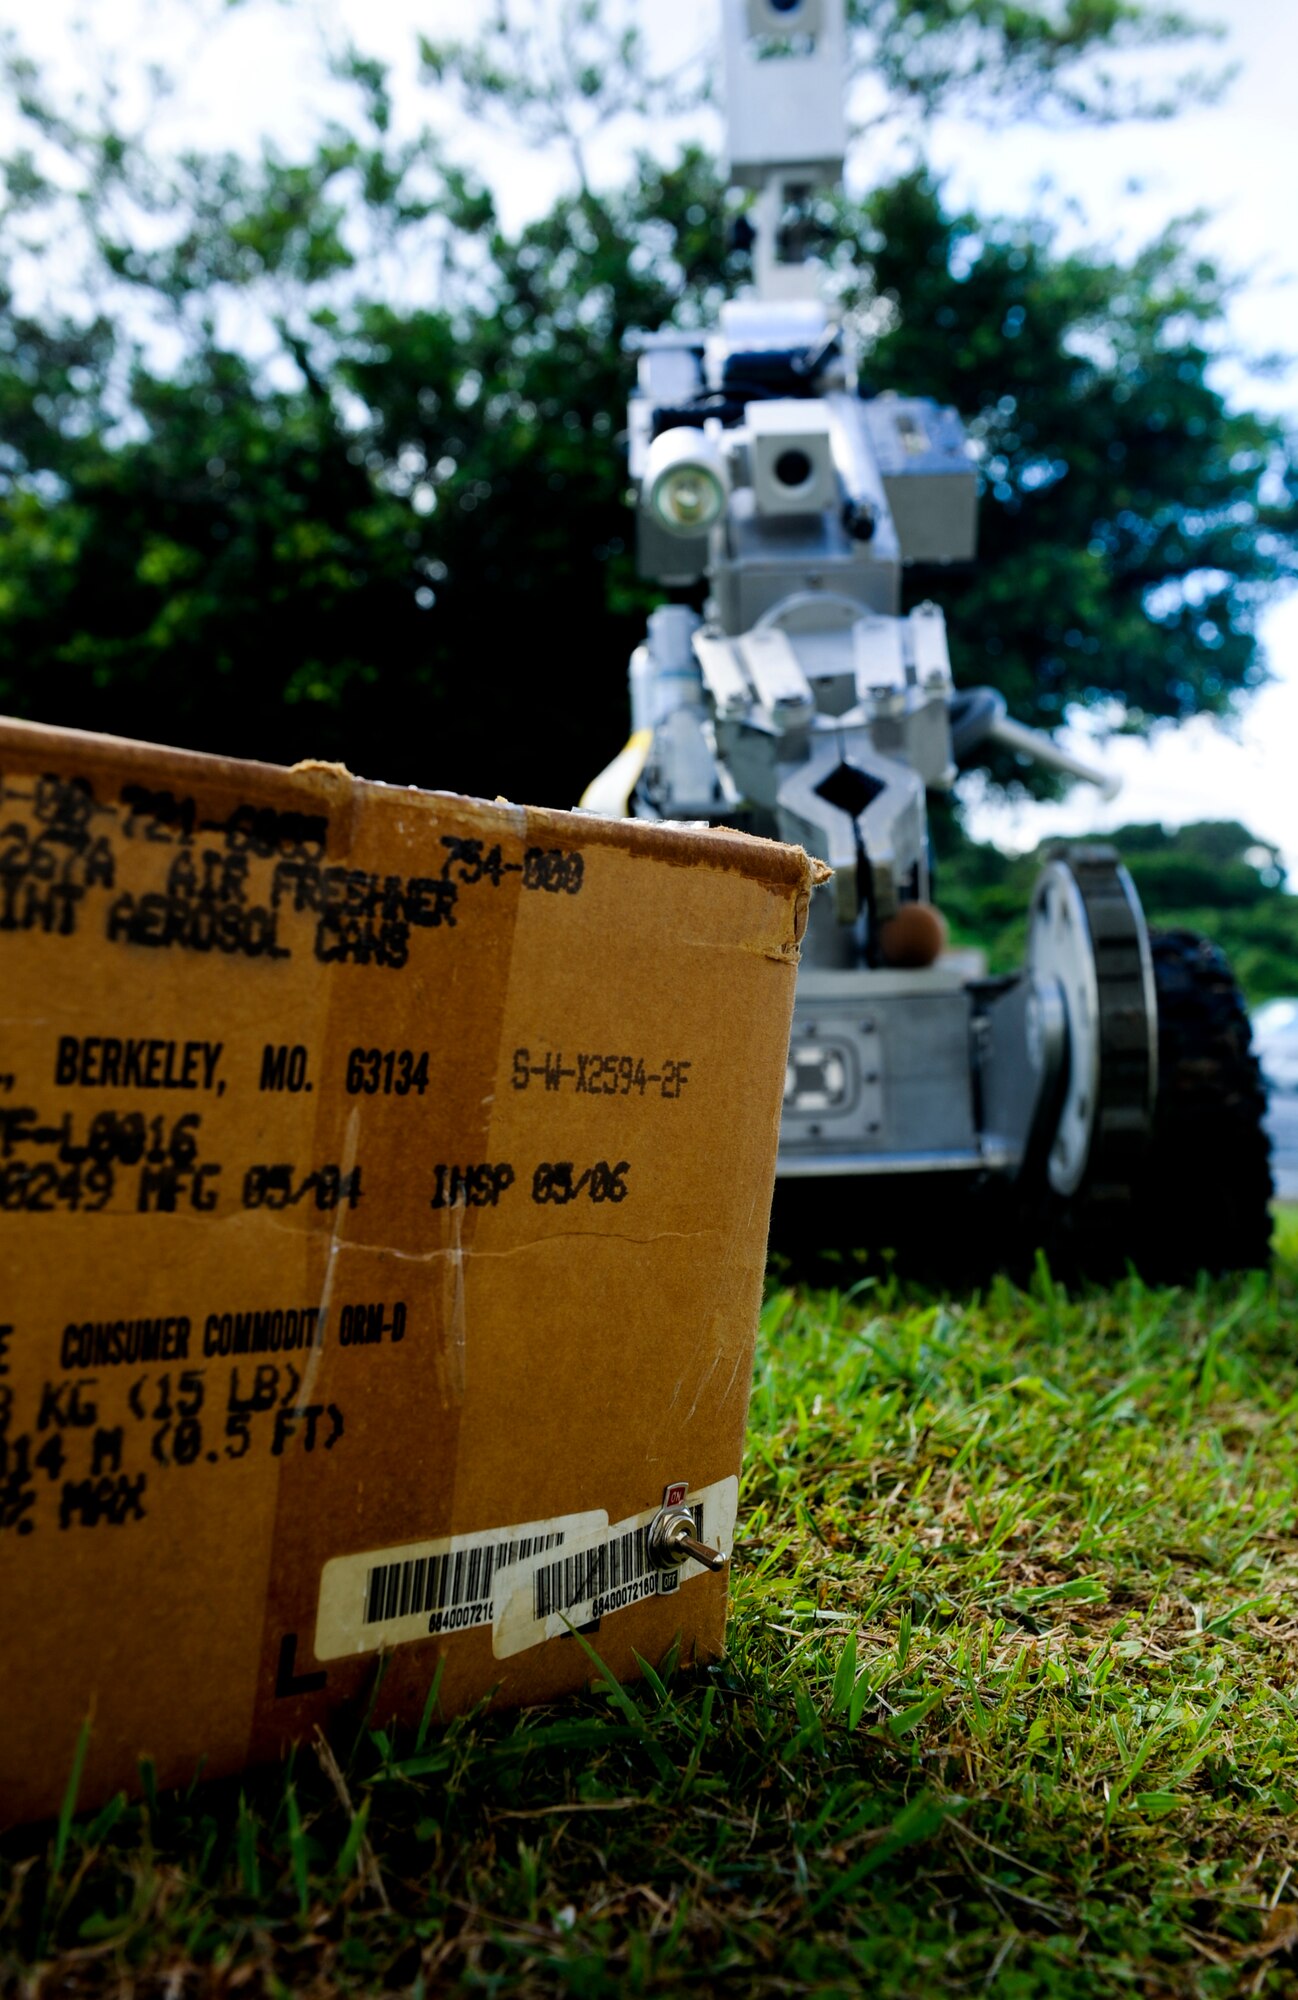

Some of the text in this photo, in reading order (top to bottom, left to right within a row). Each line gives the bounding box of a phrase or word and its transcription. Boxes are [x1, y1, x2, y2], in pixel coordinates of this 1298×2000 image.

[167, 850, 250, 904] AIR
[107, 892, 291, 960] AEROSOL
[315, 912, 410, 968] CANS
[54, 1036, 226, 1098] BERKELEY,
[259, 1044, 313, 1093] MO.
[346, 1048, 429, 1095] 63134
[137, 1163, 222, 1212] MFG
[431, 1163, 515, 1209] INSP
[60, 1316, 192, 1370] CONSUMER
[339, 1302, 407, 1347] ORM-D
[37, 1378, 99, 1431] KG
[129, 1371, 206, 1421] (15
[228, 1362, 302, 1413] LB)
[270, 1402, 346, 1457] FT)
[670, 1490, 682, 1503] ON
[663, 1574, 677, 1588] OFF
